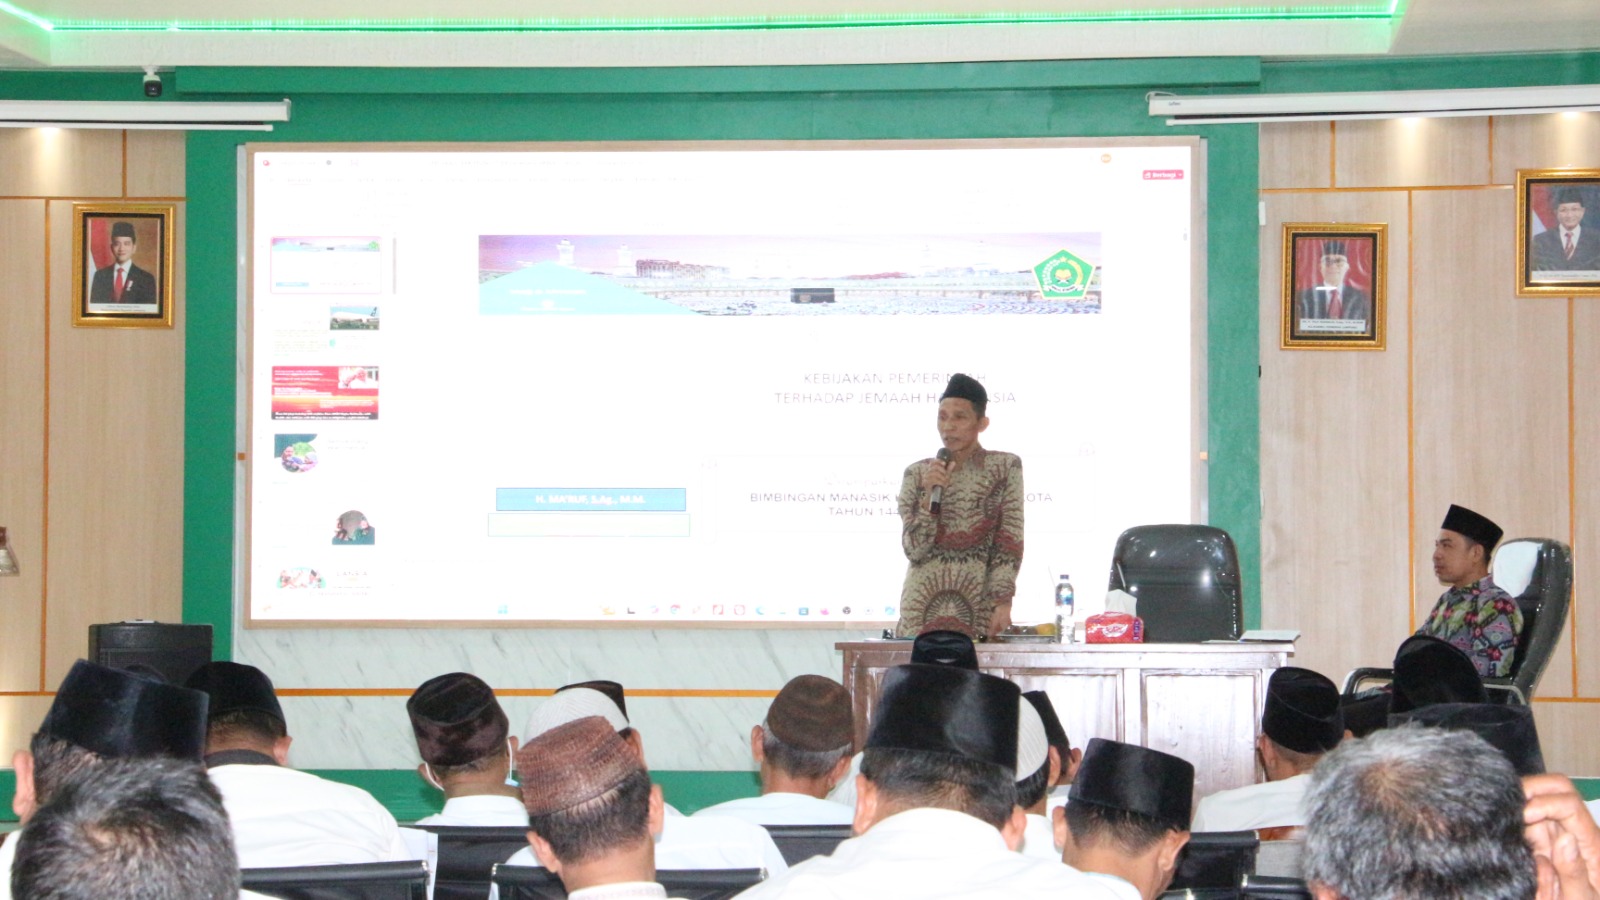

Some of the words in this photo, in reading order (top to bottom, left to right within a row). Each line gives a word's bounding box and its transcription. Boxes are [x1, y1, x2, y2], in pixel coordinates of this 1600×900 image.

[804, 372, 883, 384] KEBIJAKAN
[774, 392, 853, 404] TERHADAP
[858, 392, 921, 404] JEMAAH
[750, 492, 826, 503] BIMBINGAN
[829, 492, 891, 503] MANASIK
[828, 507, 874, 517] TAHUN
